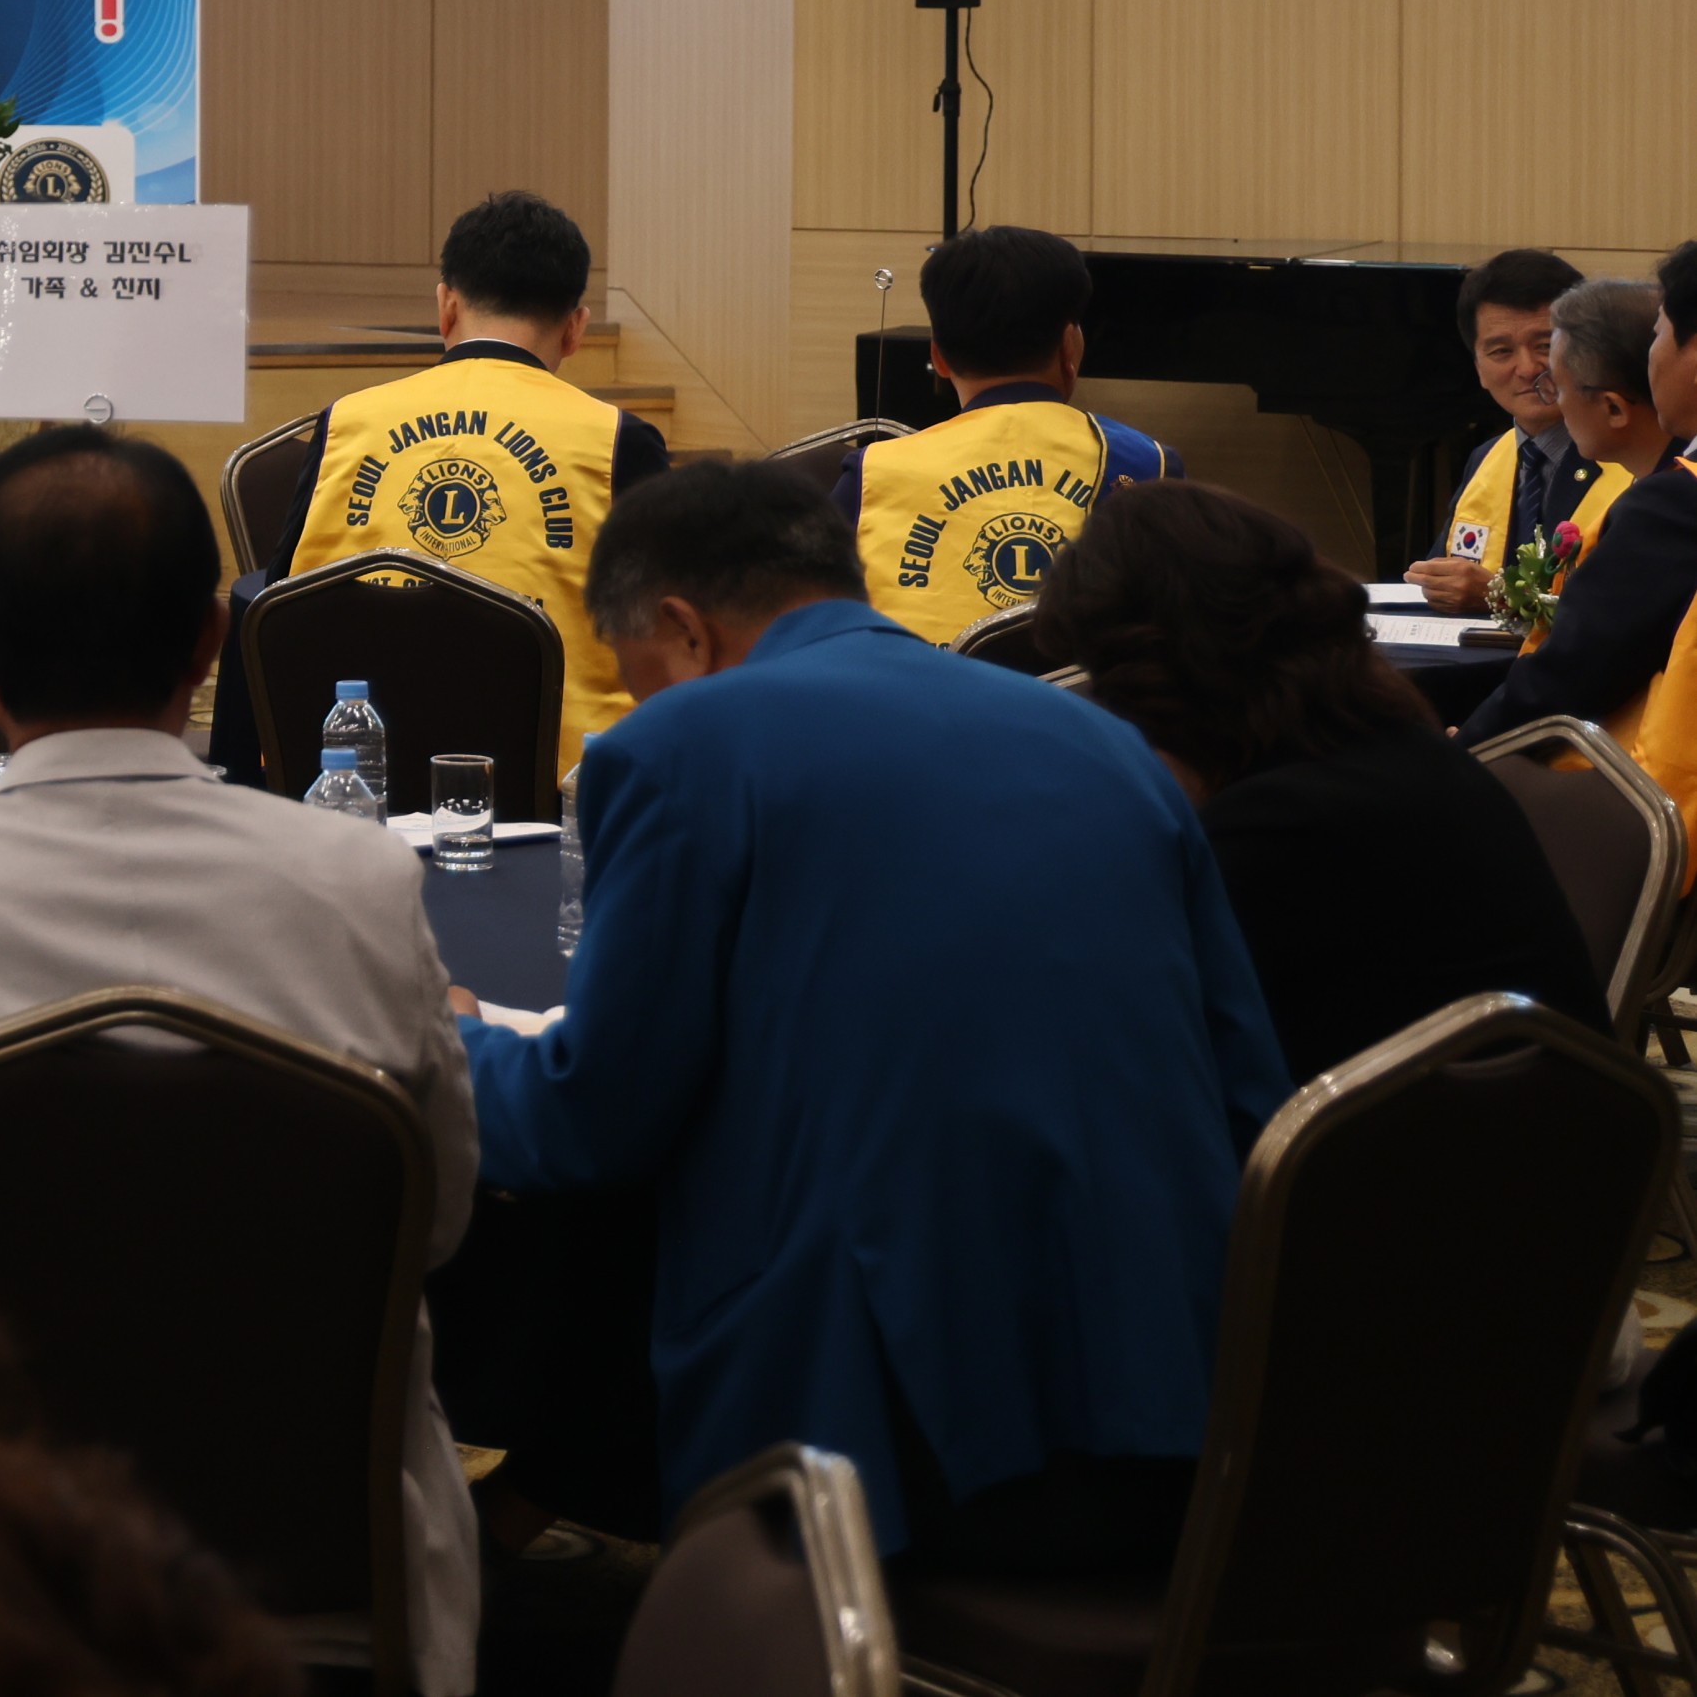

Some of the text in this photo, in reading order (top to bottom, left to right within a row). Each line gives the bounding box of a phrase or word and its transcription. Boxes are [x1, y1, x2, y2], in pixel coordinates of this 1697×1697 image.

[103, 240, 192, 264] 김진수L
[21, 276, 66, 299] 가족
[346, 410, 574, 550] SEOUL JANGAN LIONS CLUB
[426, 462, 488, 485] LIONS
[442, 489, 466, 525] L
[898, 513, 947, 588] SEOUL
[938, 459, 1044, 512] JANGAN
[990, 515, 1058, 541] LIONS
[419, 529, 477, 553] INTERNATIONAL
[1011, 544, 1041, 581] L
